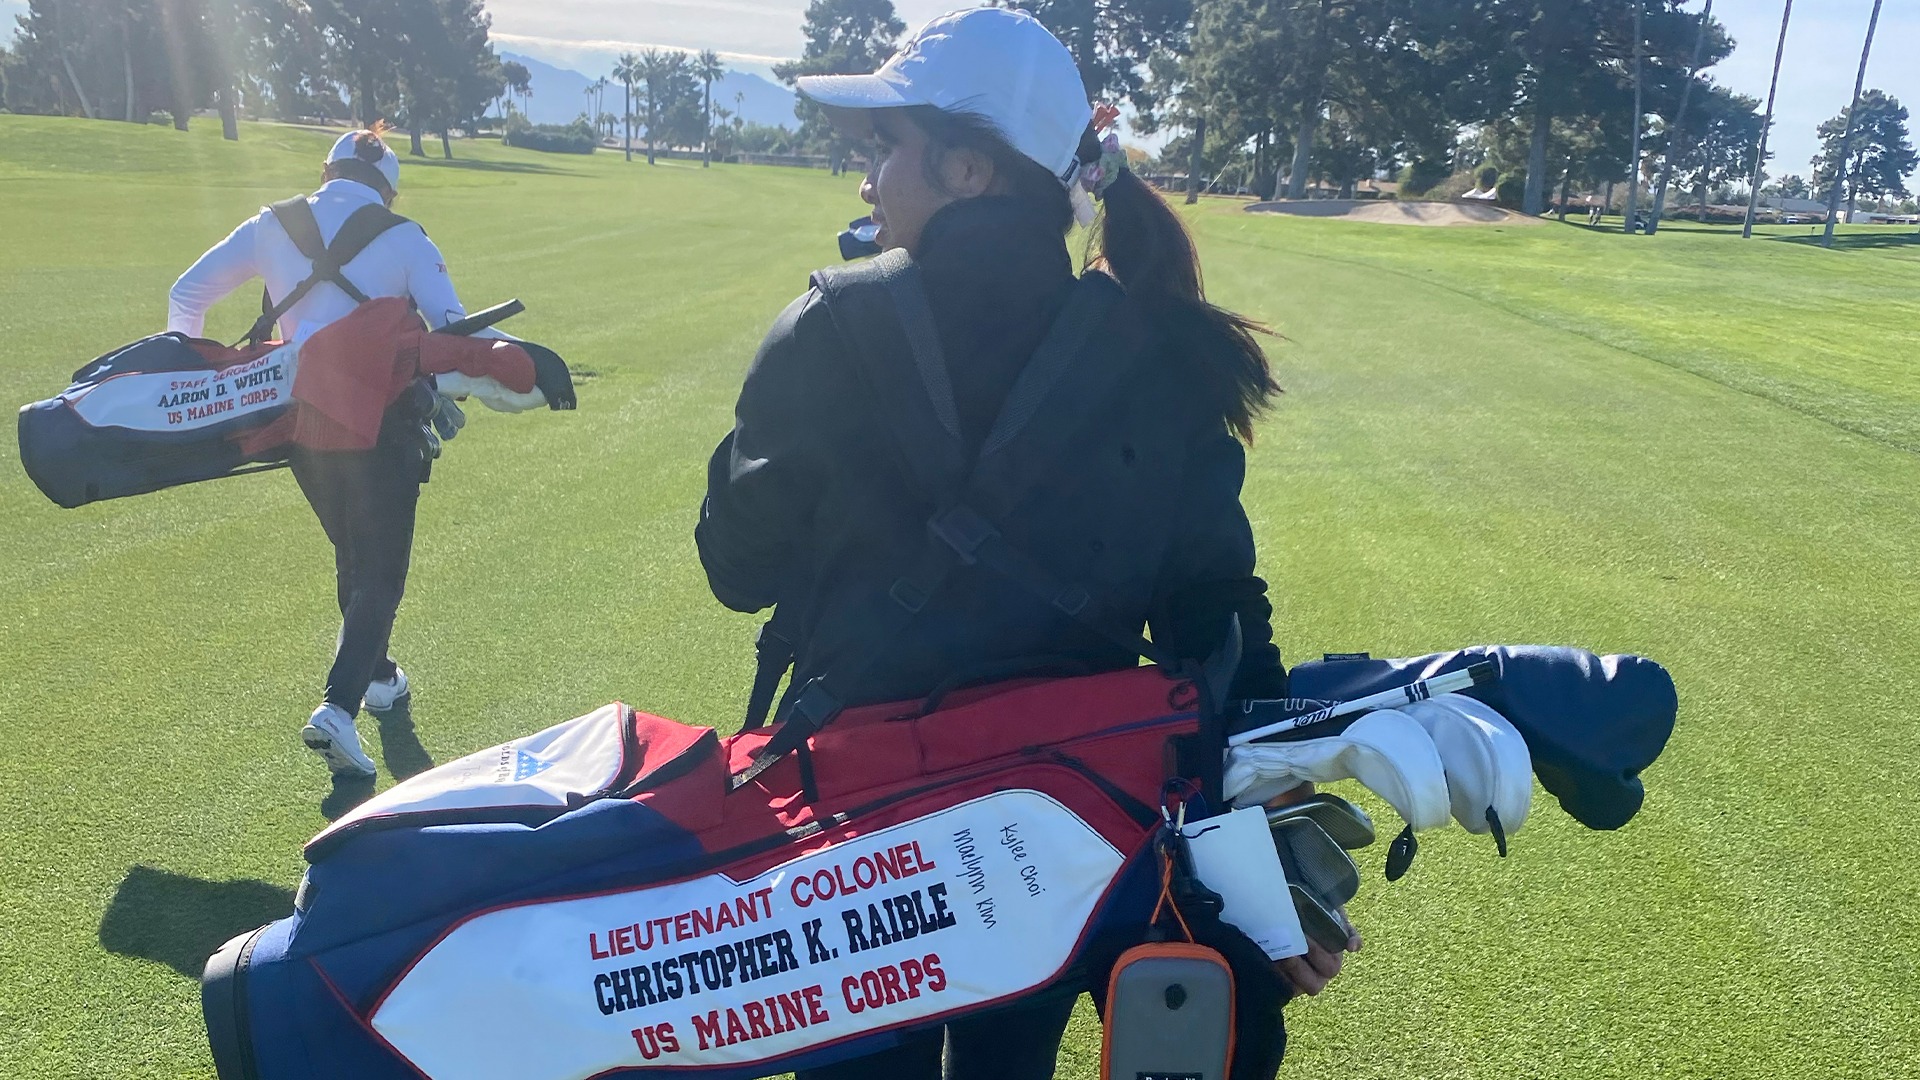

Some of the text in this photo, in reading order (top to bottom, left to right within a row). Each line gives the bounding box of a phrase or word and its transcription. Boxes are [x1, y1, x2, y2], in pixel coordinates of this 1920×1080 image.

[157, 364, 284, 408] AARON D. WHITE
[170, 356, 270, 391] STAFF SERGEANT
[167, 387, 278, 425] US MARINE CORPS
[1000, 822, 1046, 897] Kylee Choi
[590, 839, 935, 960] LIEUTENANT COLONEL
[976, 897, 997, 930] Kim
[594, 882, 957, 1016] CHRISTOPHER K. RAIBLE
[632, 953, 947, 1060] US MARINE CORPS
